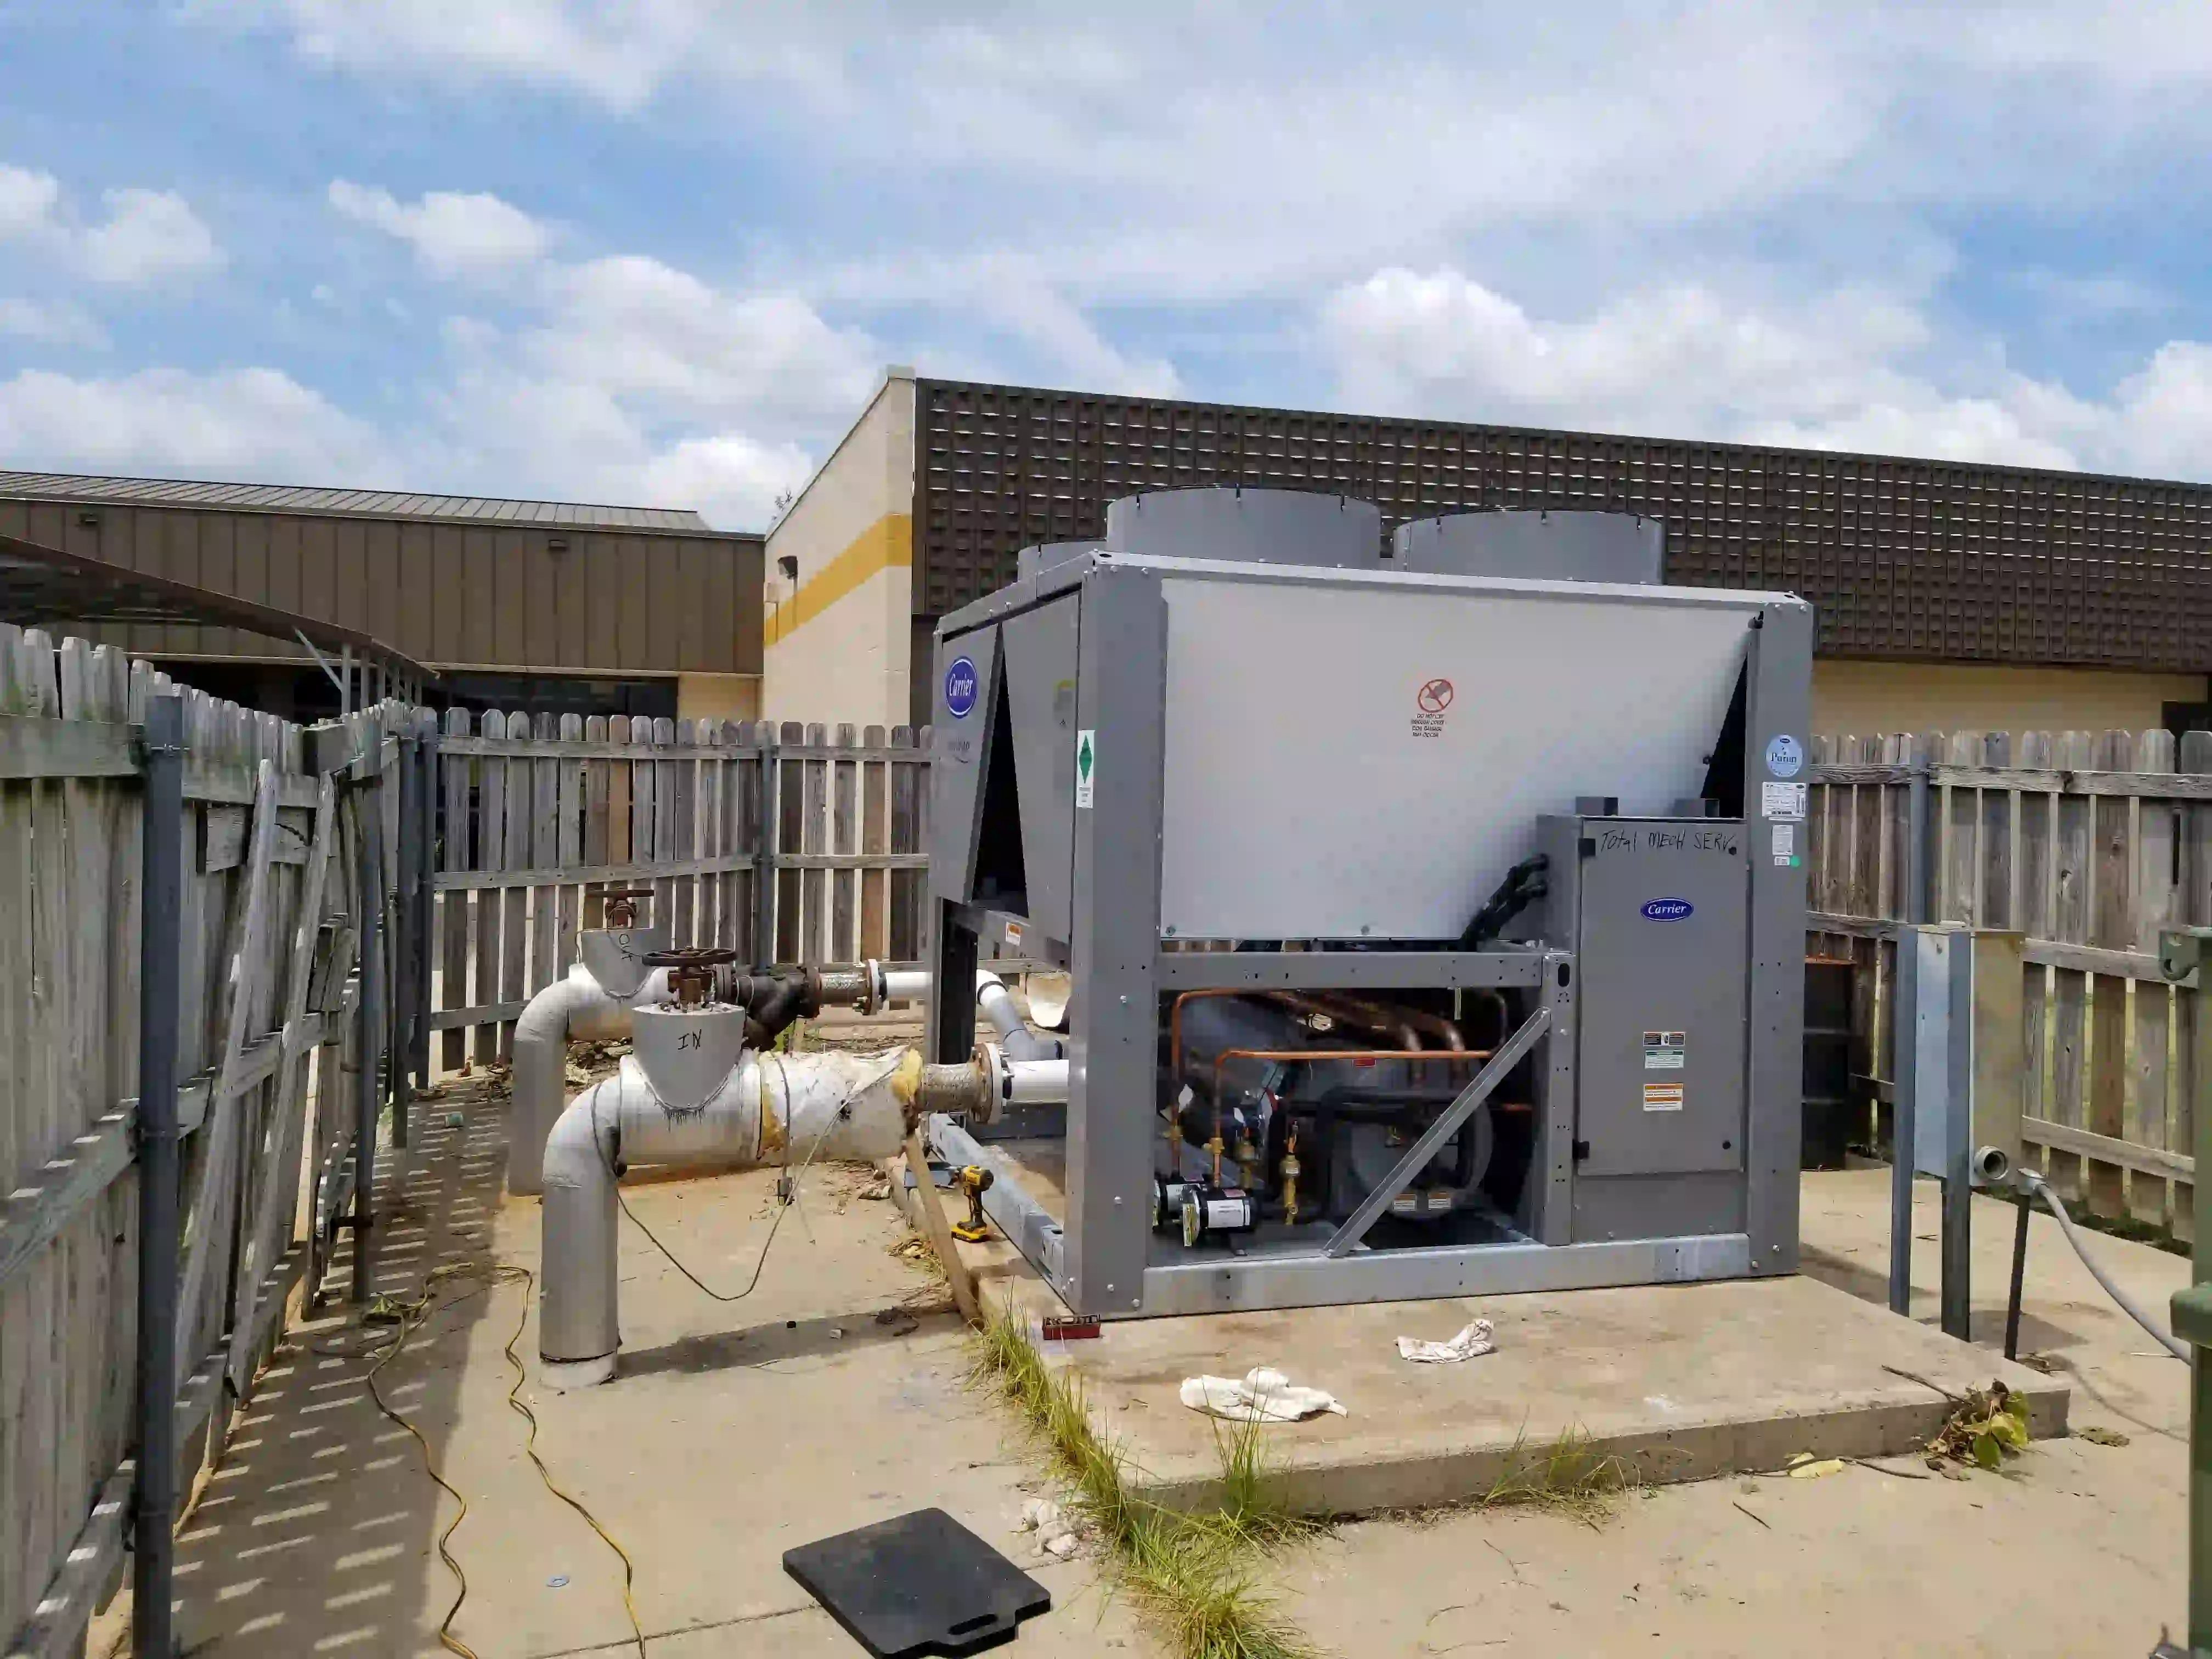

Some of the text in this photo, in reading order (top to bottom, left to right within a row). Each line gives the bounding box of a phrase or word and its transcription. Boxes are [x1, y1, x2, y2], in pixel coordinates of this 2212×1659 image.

[950, 673, 973, 697] Carrier
[1648, 828, 1686, 850] MECH
[1647, 902, 1686, 915] Carrier
[678, 1029, 702, 1051] IN
